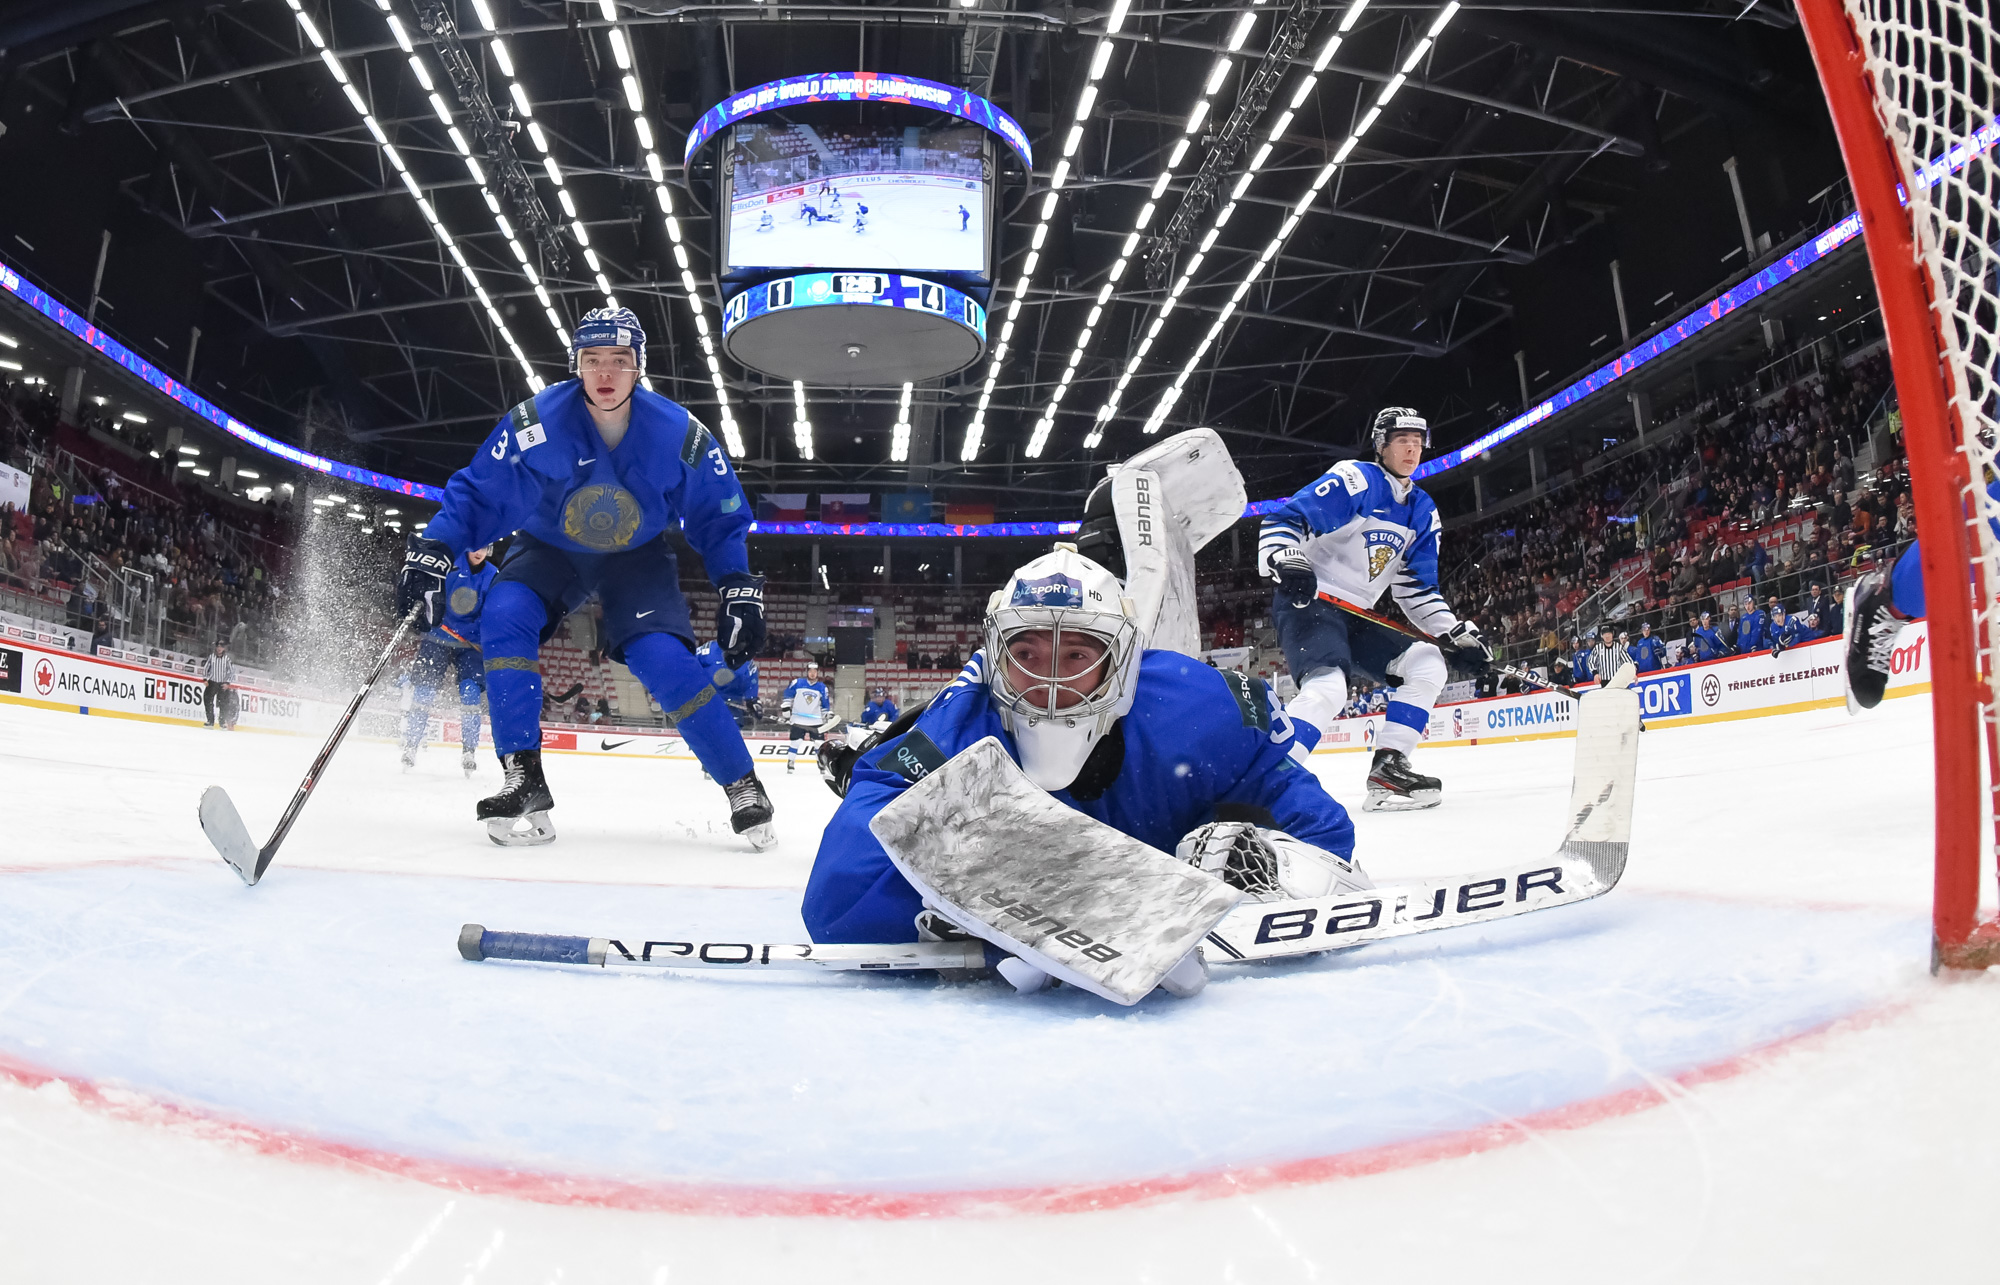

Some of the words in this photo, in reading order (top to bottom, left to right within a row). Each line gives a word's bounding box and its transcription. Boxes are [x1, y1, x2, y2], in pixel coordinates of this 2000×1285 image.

[779, 81, 820, 100] WORLD
[820, 79, 863, 95] JUNIOR
[865, 79, 952, 105] CHAMPIONSHIP
[731, 199, 764, 212] EllisDon
[777, 282, 786, 306] 1
[926, 286, 939, 310] 4
[969, 302, 977, 329] 1
[491, 430, 509, 460] 3
[526, 430, 535, 443] HD
[708, 446, 728, 476] 3
[1088, 589, 1103, 602] HD
[58, 672, 80, 692] AIR
[83, 676, 136, 700] CANADA
[1728, 674, 1776, 691] TŘINECKÉ
[1779, 664, 1840, 684] ŽELEZÁRNY
[168, 681, 203, 706] TISS
[144, 703, 162, 714] SWISS
[259, 696, 302, 719] TISSOT
[1487, 700, 1570, 729] OSTRAVA!!!
